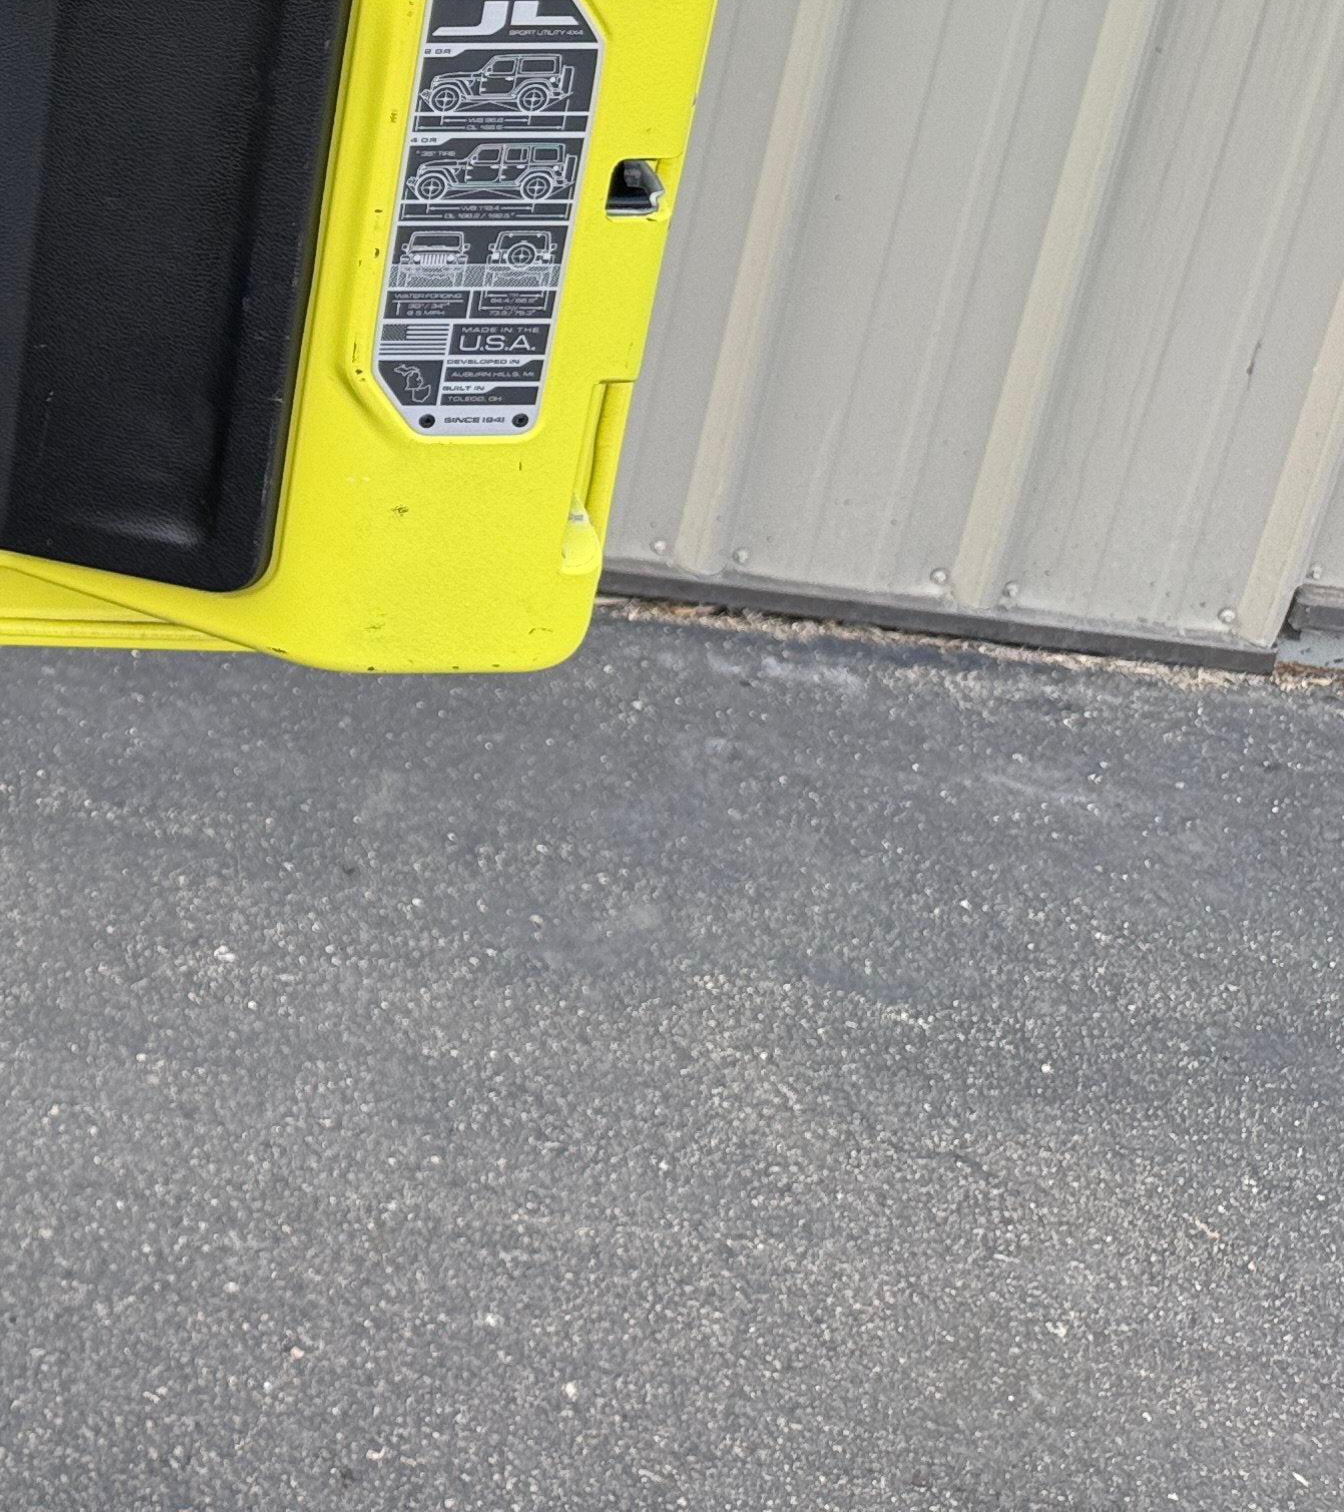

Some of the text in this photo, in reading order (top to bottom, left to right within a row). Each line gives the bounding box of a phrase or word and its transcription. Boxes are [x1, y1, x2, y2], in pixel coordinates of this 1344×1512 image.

[431, 0, 580, 37] JL
[508, 29, 536, 37] SPORT
[536, 29, 565, 37] UTILITY
[461, 326, 540, 334] MADE IN THE
[459, 334, 537, 352] U.S.A.
[450, 370, 492, 378] AUBURN
[443, 416, 481, 424] SINCE
